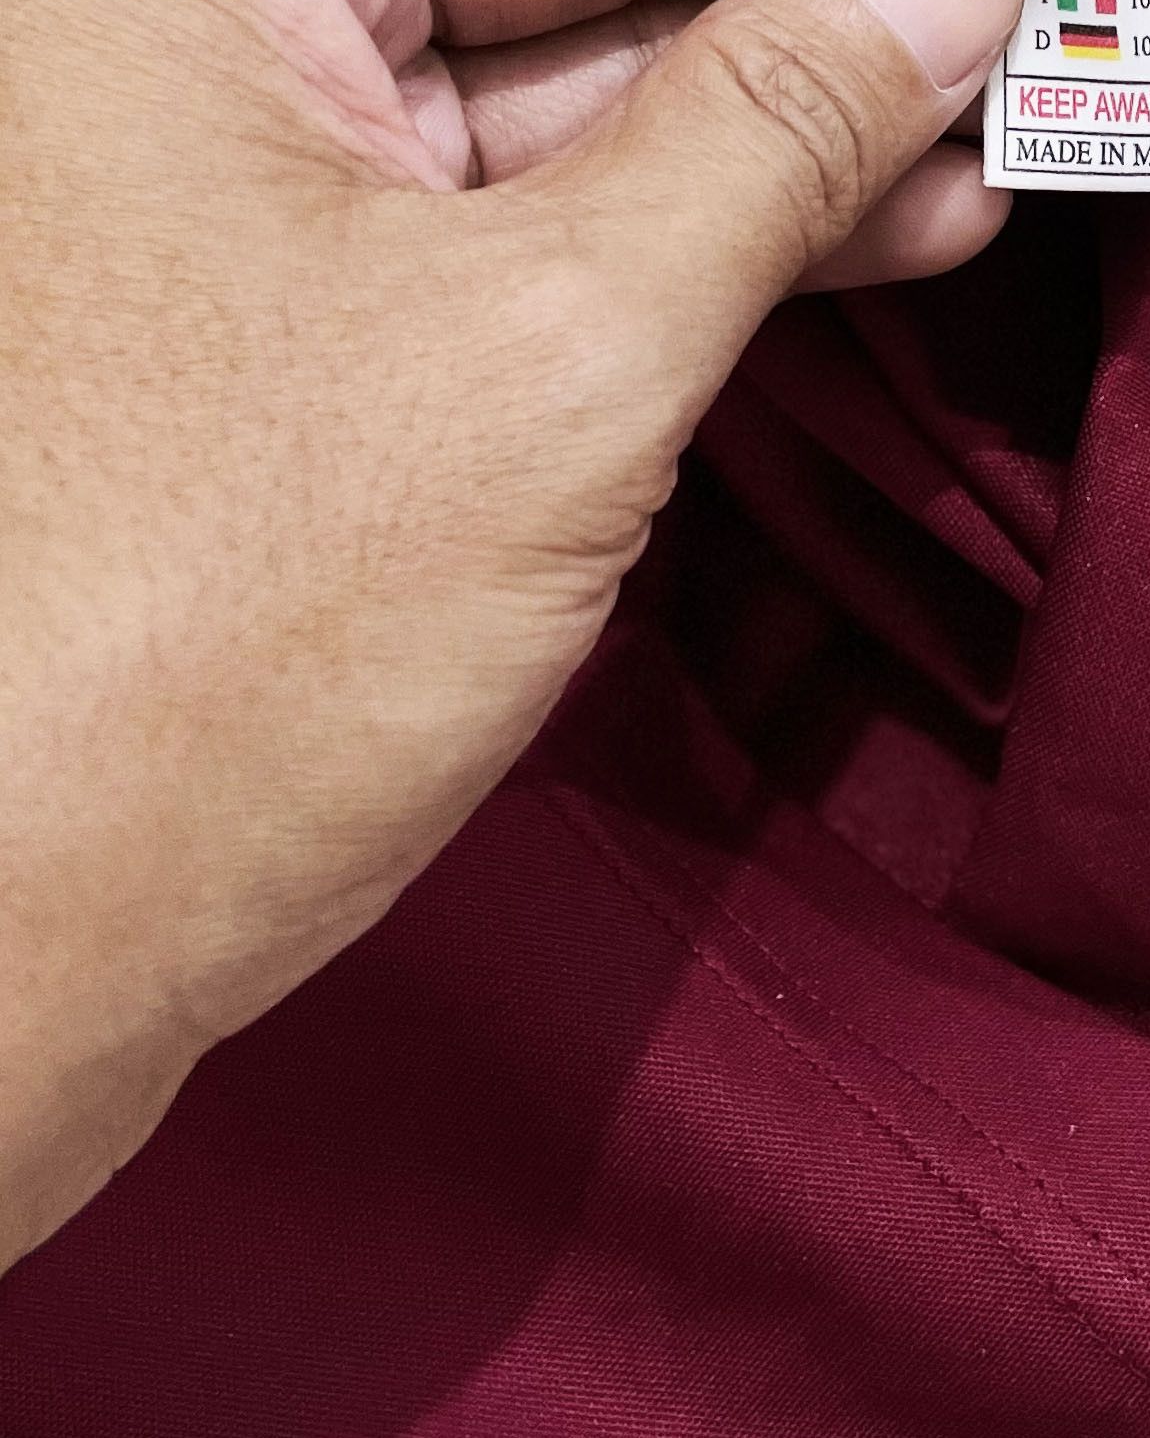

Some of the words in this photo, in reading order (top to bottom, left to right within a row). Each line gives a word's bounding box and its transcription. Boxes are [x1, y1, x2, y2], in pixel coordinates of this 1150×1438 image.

[1035, 30, 1051, 51] D
[1019, 86, 1088, 120] KEEP
[1016, 137, 1092, 165] MADE
[1100, 141, 1126, 166] IN
